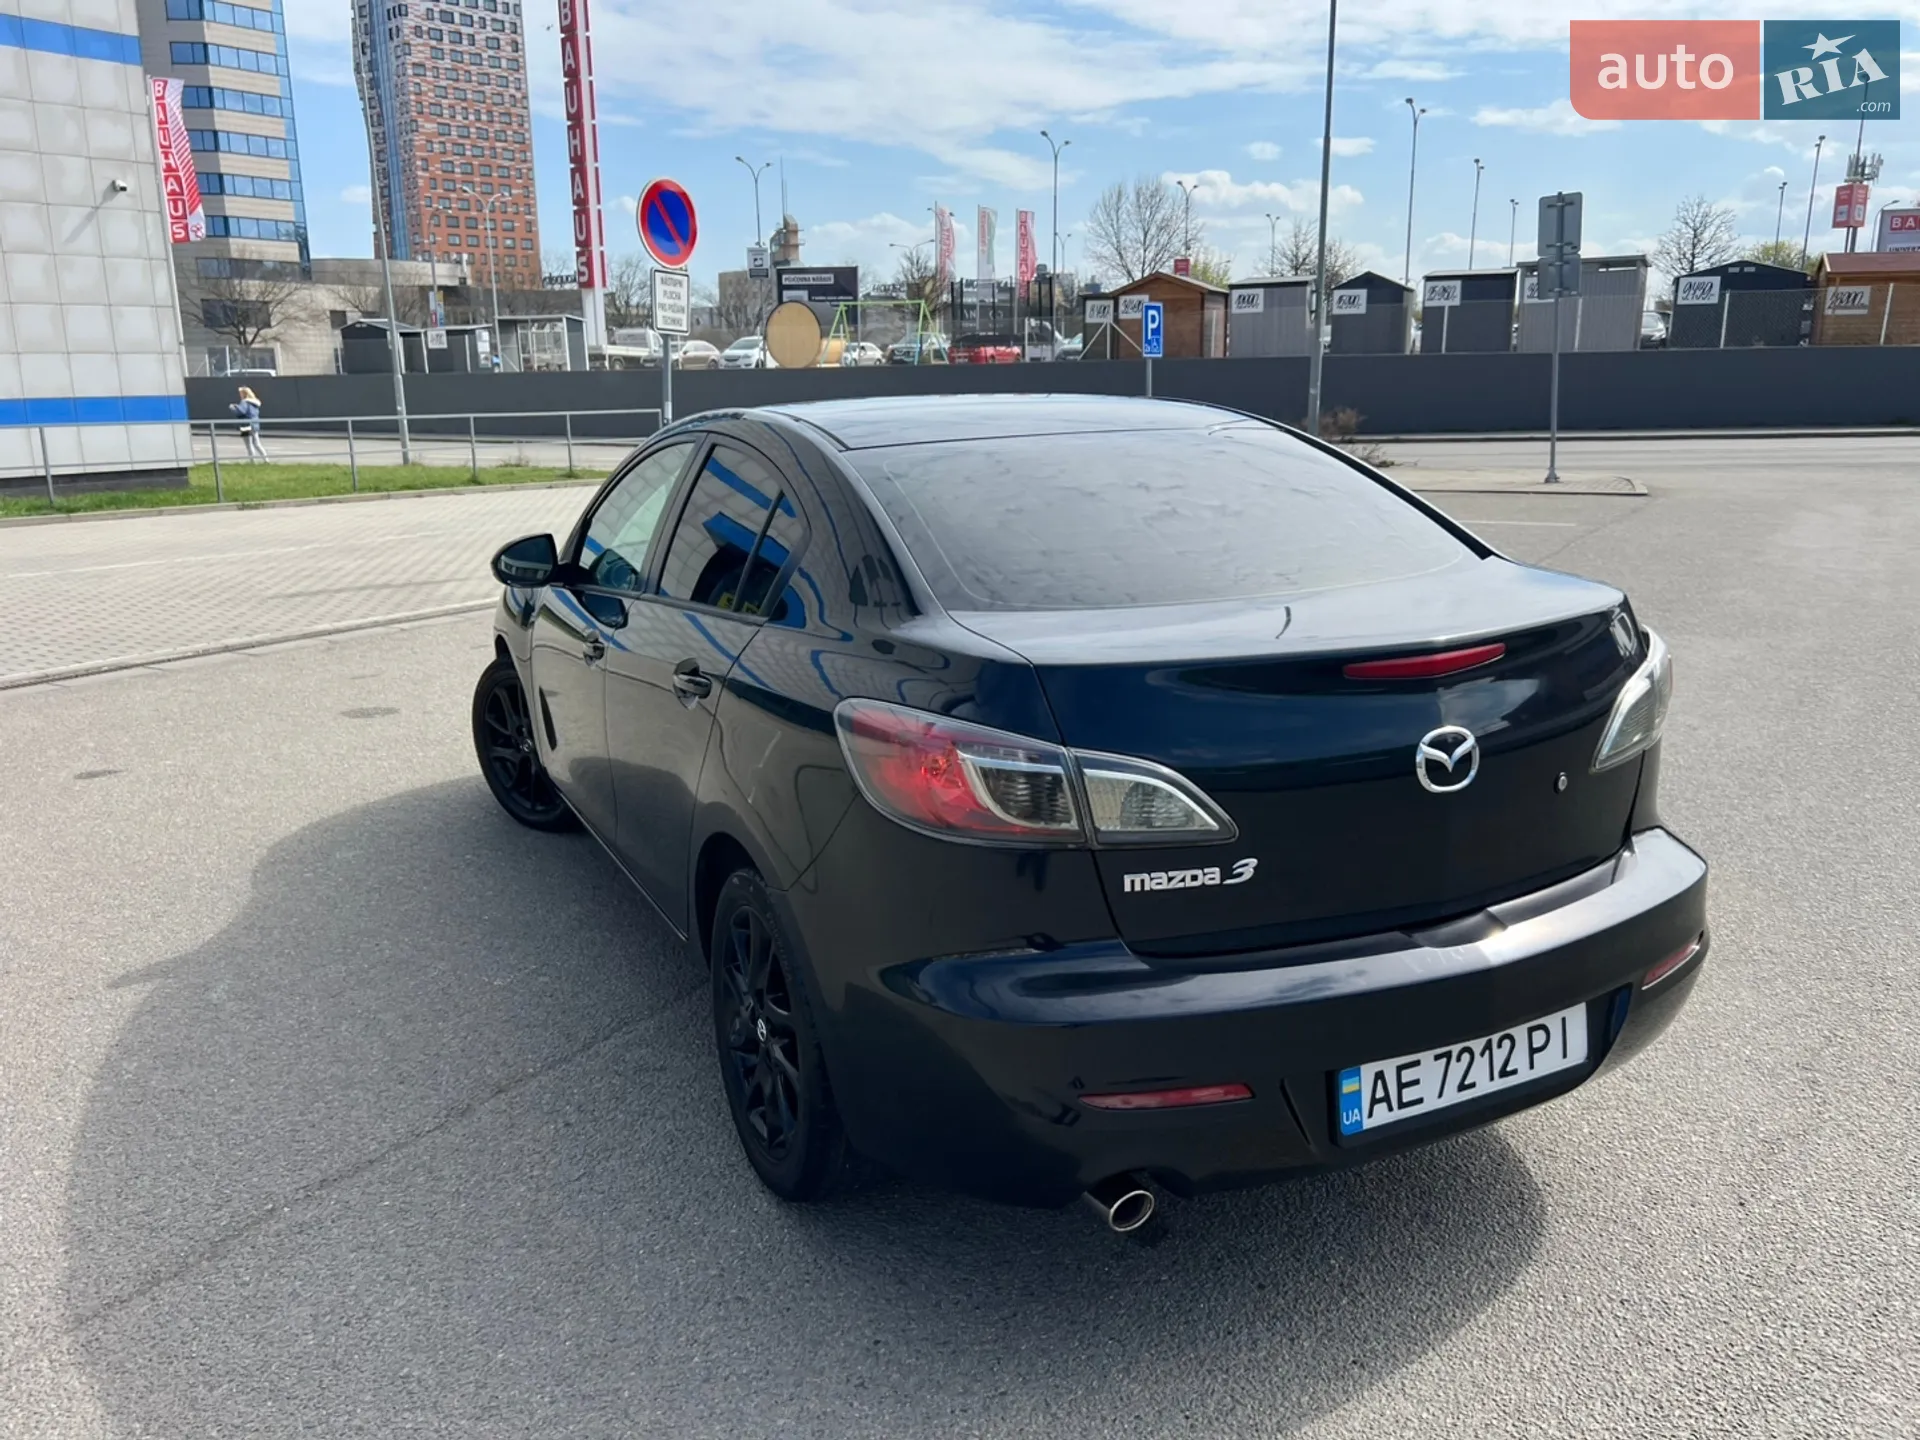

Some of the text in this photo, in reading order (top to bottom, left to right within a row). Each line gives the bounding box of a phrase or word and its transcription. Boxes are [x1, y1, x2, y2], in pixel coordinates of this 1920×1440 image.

[154, 81, 187, 239] BAUHAUS
[560, 0, 588, 283] BAUHAUS
[1222, 858, 1259, 885] 3
[1343, 1110, 1361, 1126] UA
